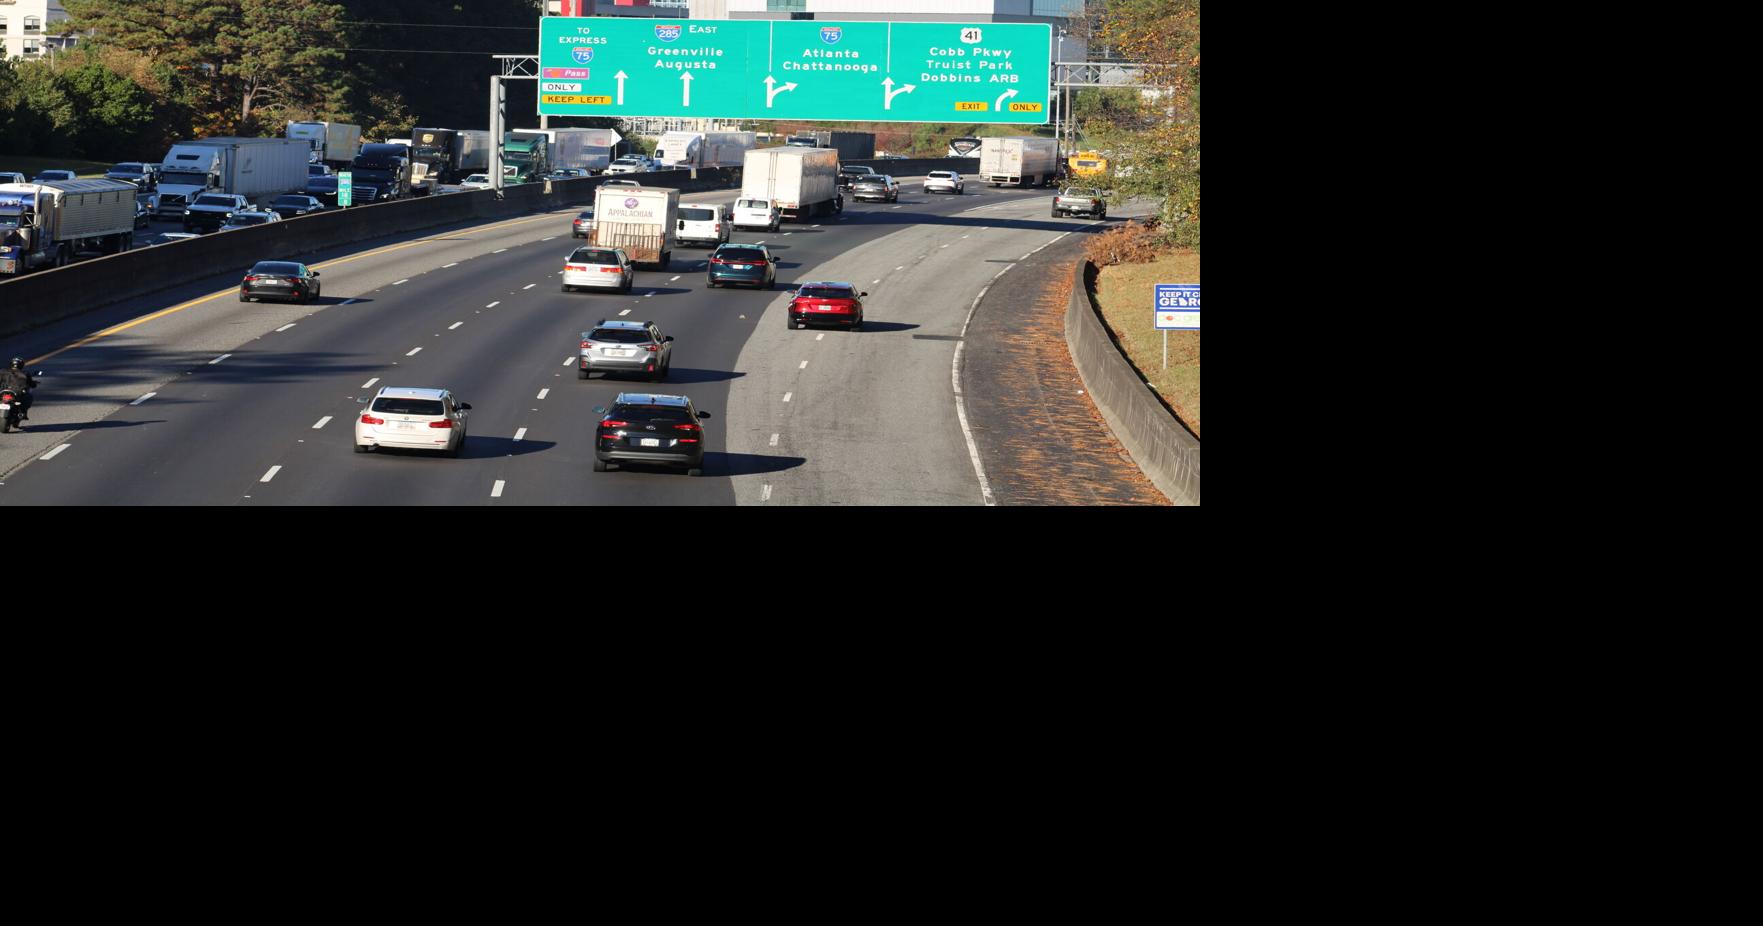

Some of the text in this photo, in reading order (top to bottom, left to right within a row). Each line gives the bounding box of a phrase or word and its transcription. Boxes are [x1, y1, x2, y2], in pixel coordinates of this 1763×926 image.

[659, 29, 679, 38] 285
[824, 32, 838, 41] 75
[964, 31, 978, 41] 41
[576, 51, 590, 61] 75
[647, 46, 724, 57] Greenville
[803, 48, 859, 58] Atlanta
[929, 47, 1012, 59] Cobb Pkwy
[655, 60, 716, 70] Augusta
[782, 61, 878, 74] Chattanooga
[926, 60, 1013, 70] Truist Park
[921, 73, 1019, 83] Dobbins ARB
[547, 83, 576, 91] ONLY
[608, 209, 653, 217] APPALACHIAN
